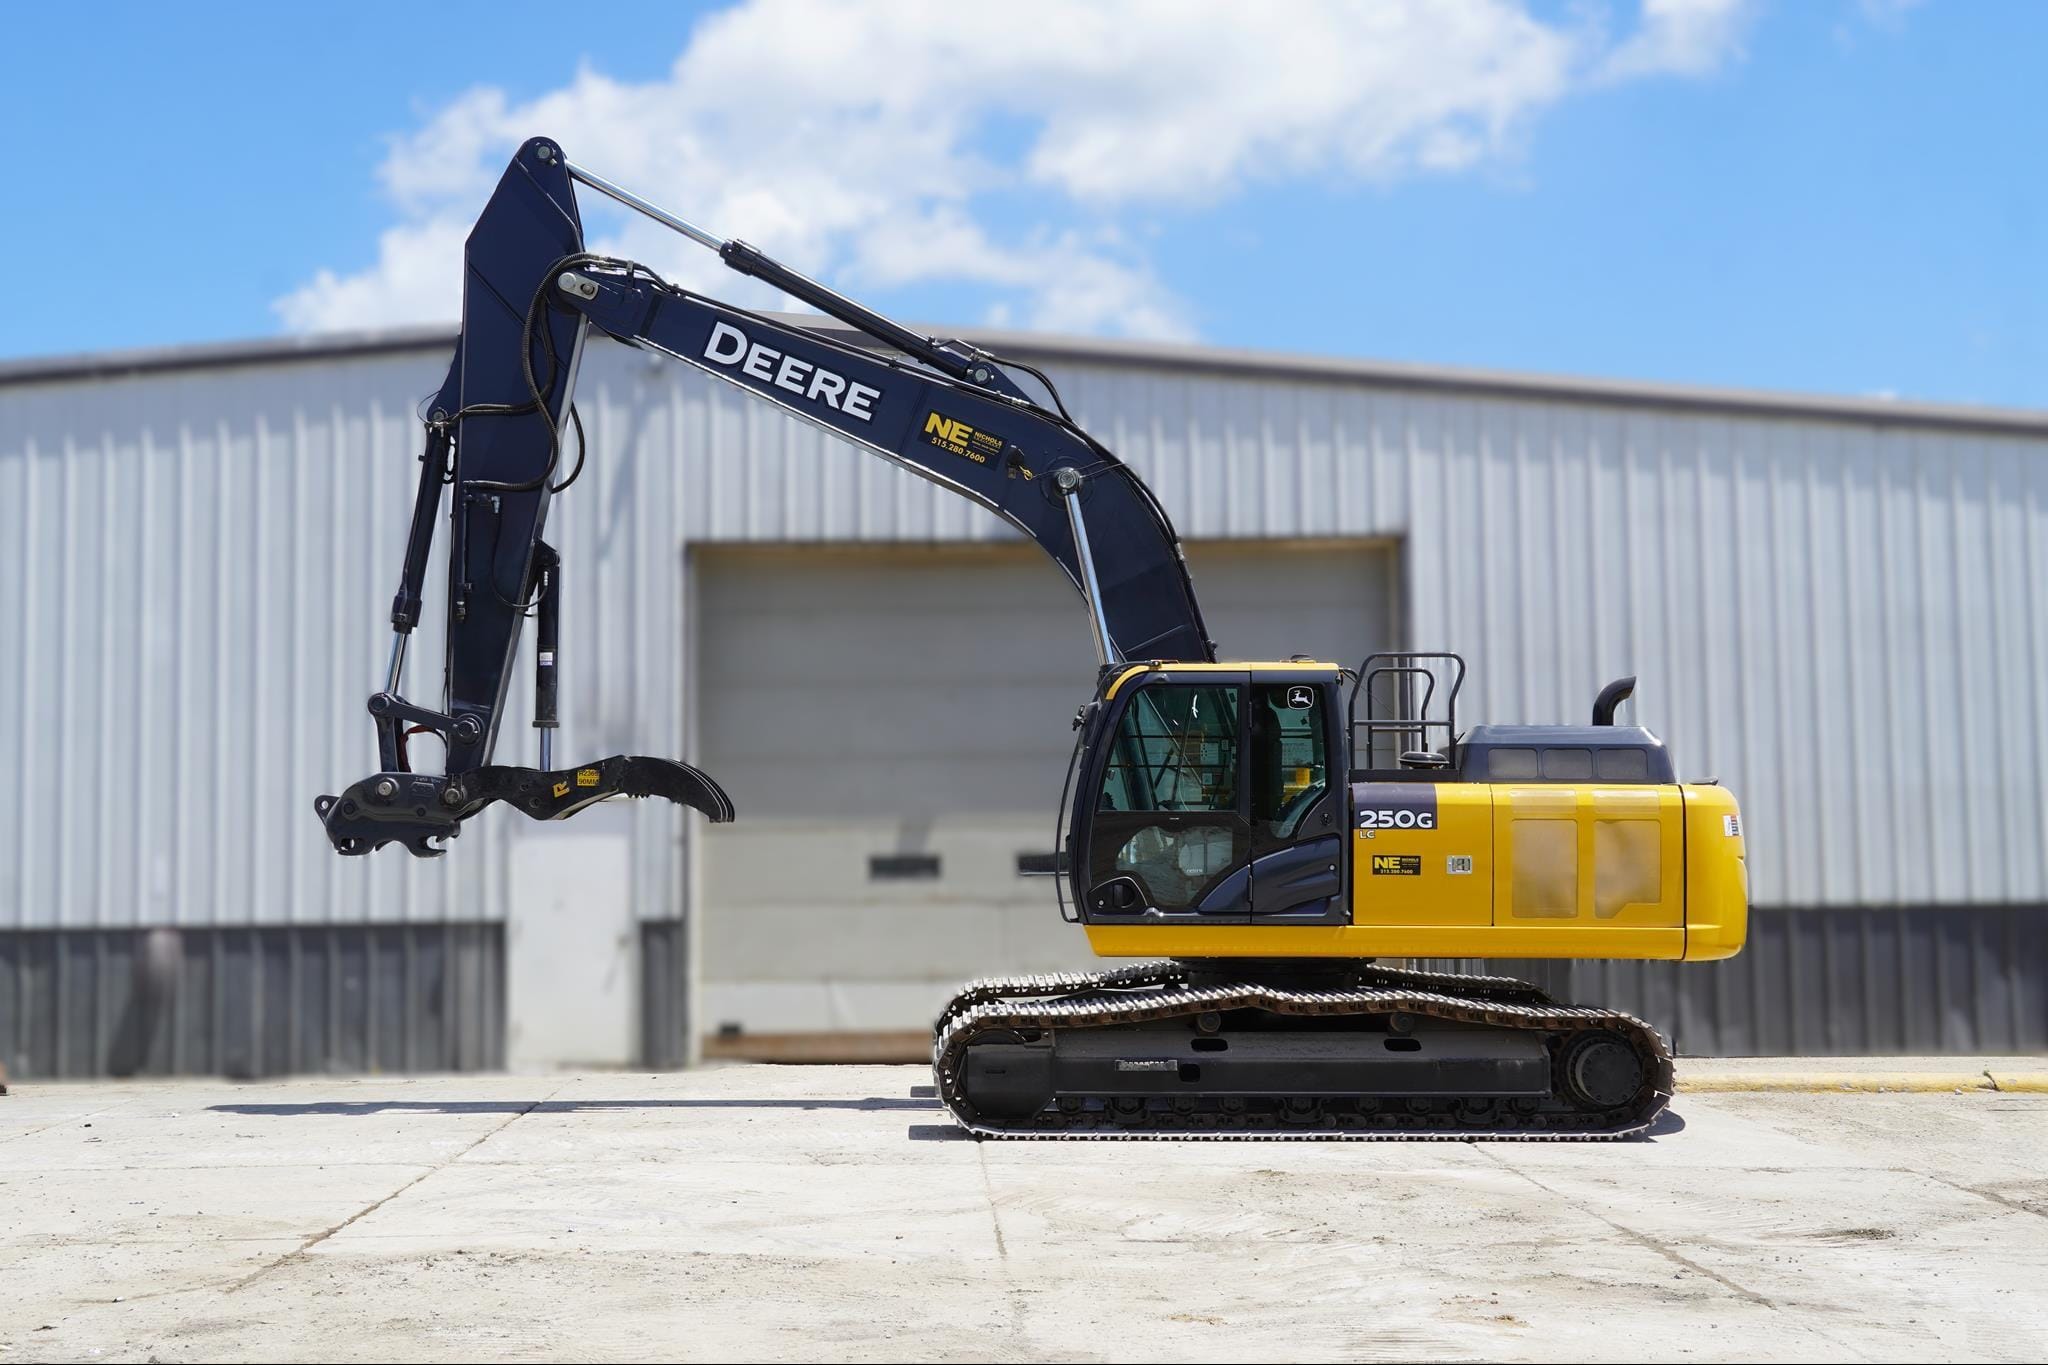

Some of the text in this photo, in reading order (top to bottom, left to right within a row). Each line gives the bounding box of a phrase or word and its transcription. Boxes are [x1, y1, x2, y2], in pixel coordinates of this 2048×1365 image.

[703, 321, 881, 421] DEERE
[924, 412, 974, 447] NE
[974, 431, 1003, 447] NICHOLS
[931, 436, 986, 463] 515.280.7600
[1360, 810, 1433, 828] 250G
[1360, 830, 1375, 839] LC
[1374, 857, 1400, 869] NE
